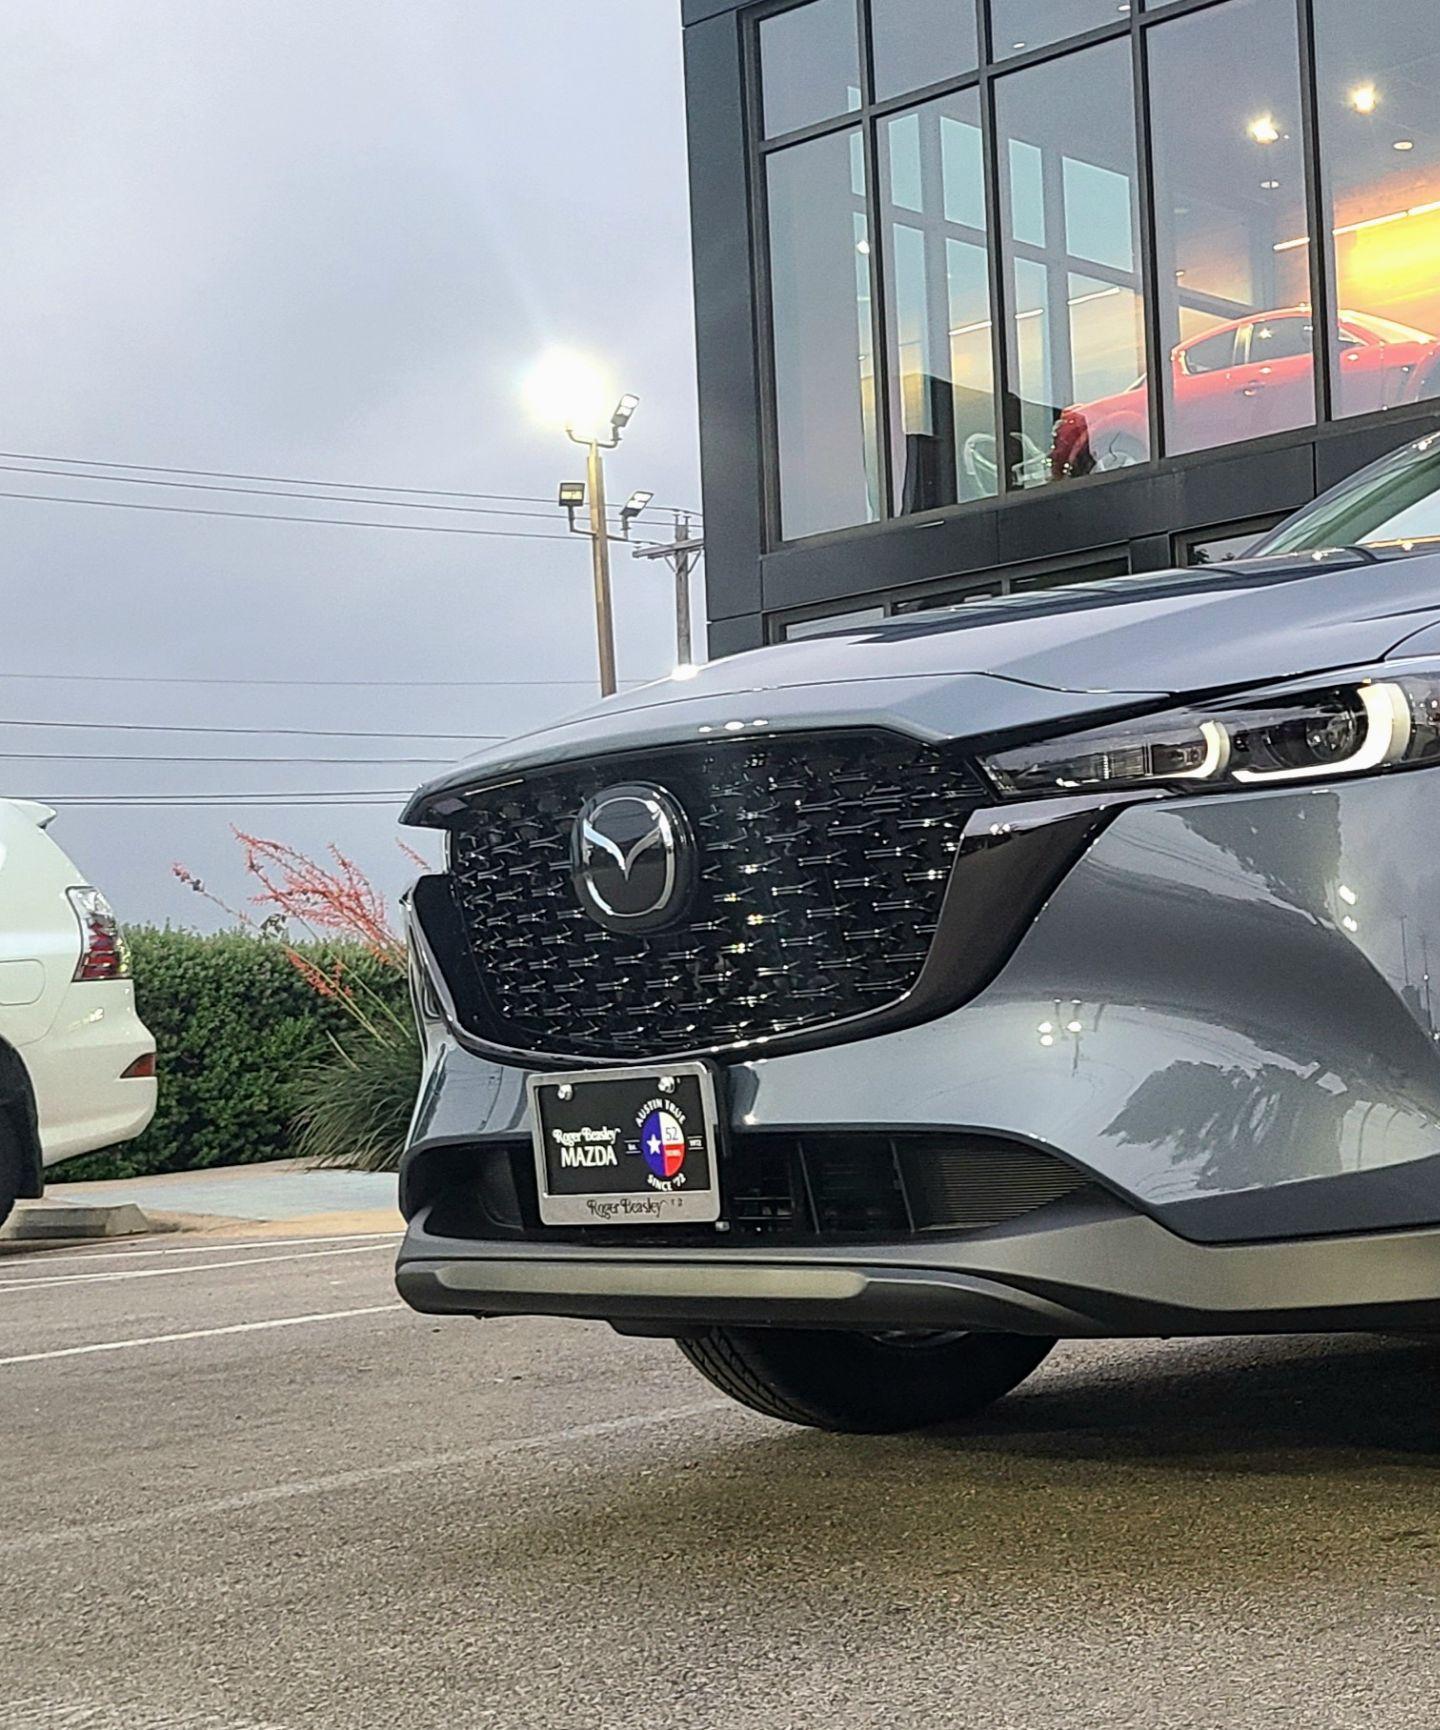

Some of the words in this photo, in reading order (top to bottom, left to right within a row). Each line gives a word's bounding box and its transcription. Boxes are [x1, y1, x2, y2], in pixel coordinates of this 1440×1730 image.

[635, 1098, 663, 1127] AUSTIN
[664, 1099, 686, 1124] TRUE
[552, 1129, 581, 1147] Roger
[581, 1126, 621, 1145] Beasley
[665, 1127, 678, 1141] 52
[561, 1145, 617, 1167] MAZDA
[647, 1174, 673, 1191] SINCE
[587, 1199, 619, 1220] Roger
[620, 1197, 668, 1218] Beasley
